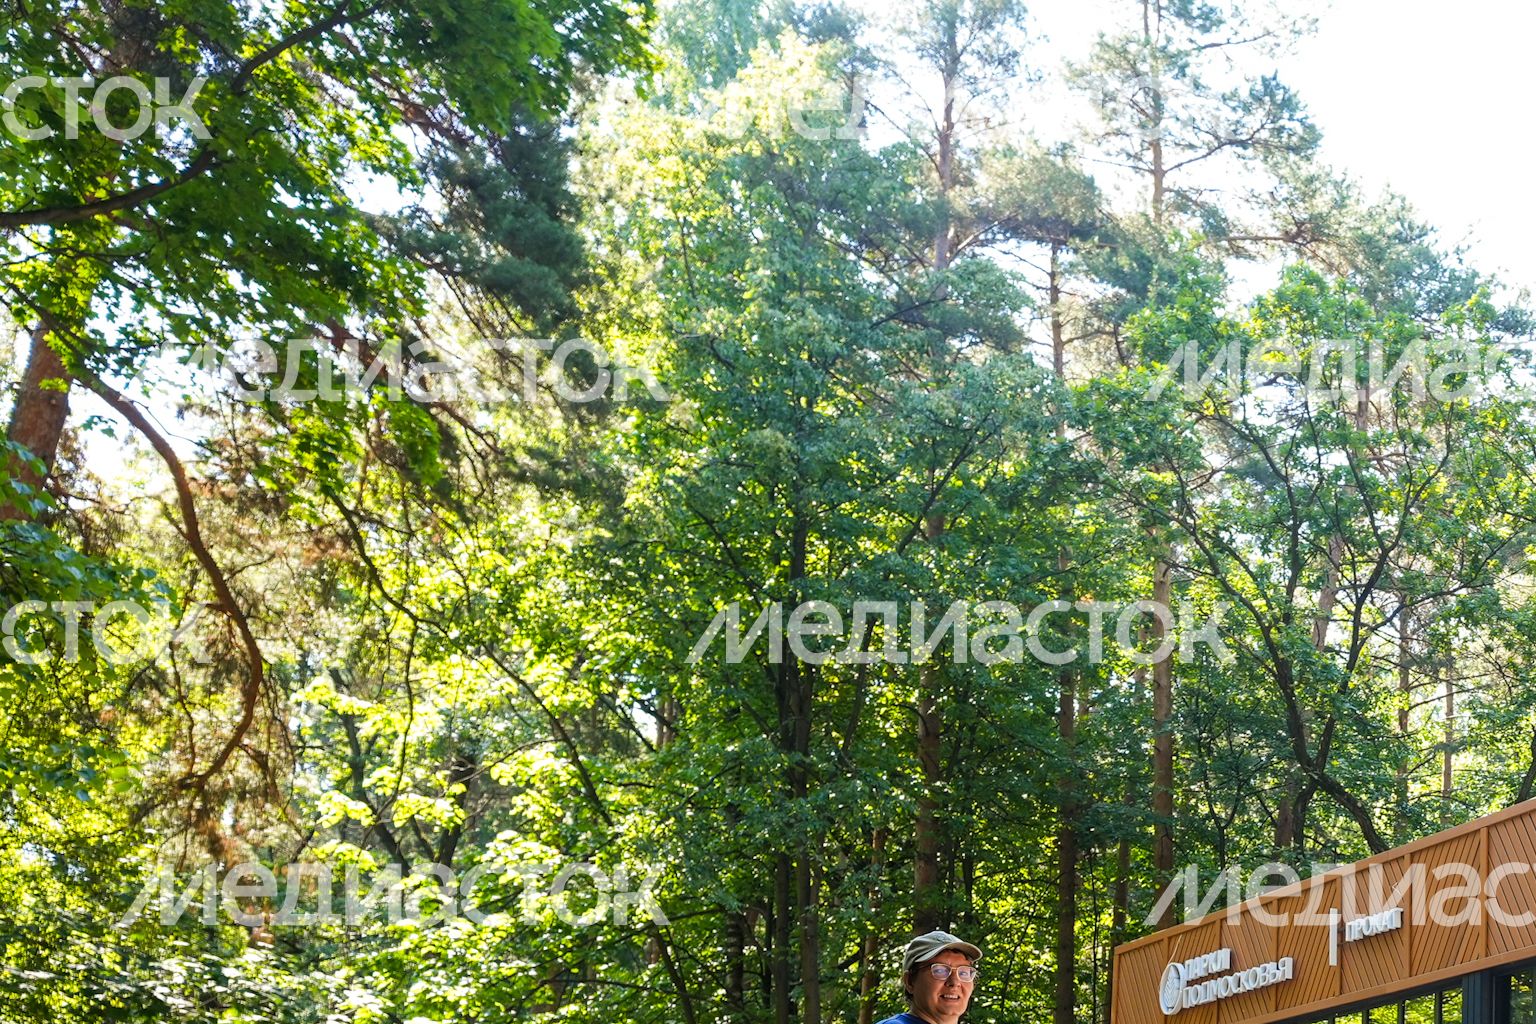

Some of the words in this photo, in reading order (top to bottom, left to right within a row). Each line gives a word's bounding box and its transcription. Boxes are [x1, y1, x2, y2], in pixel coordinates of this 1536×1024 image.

[1345, 907, 1404, 942] ПРОКАТ
[1184, 948, 1231, 982] ПАРКИ
[1182, 957, 1294, 1009] ПОДМОСКОВЬЯ
